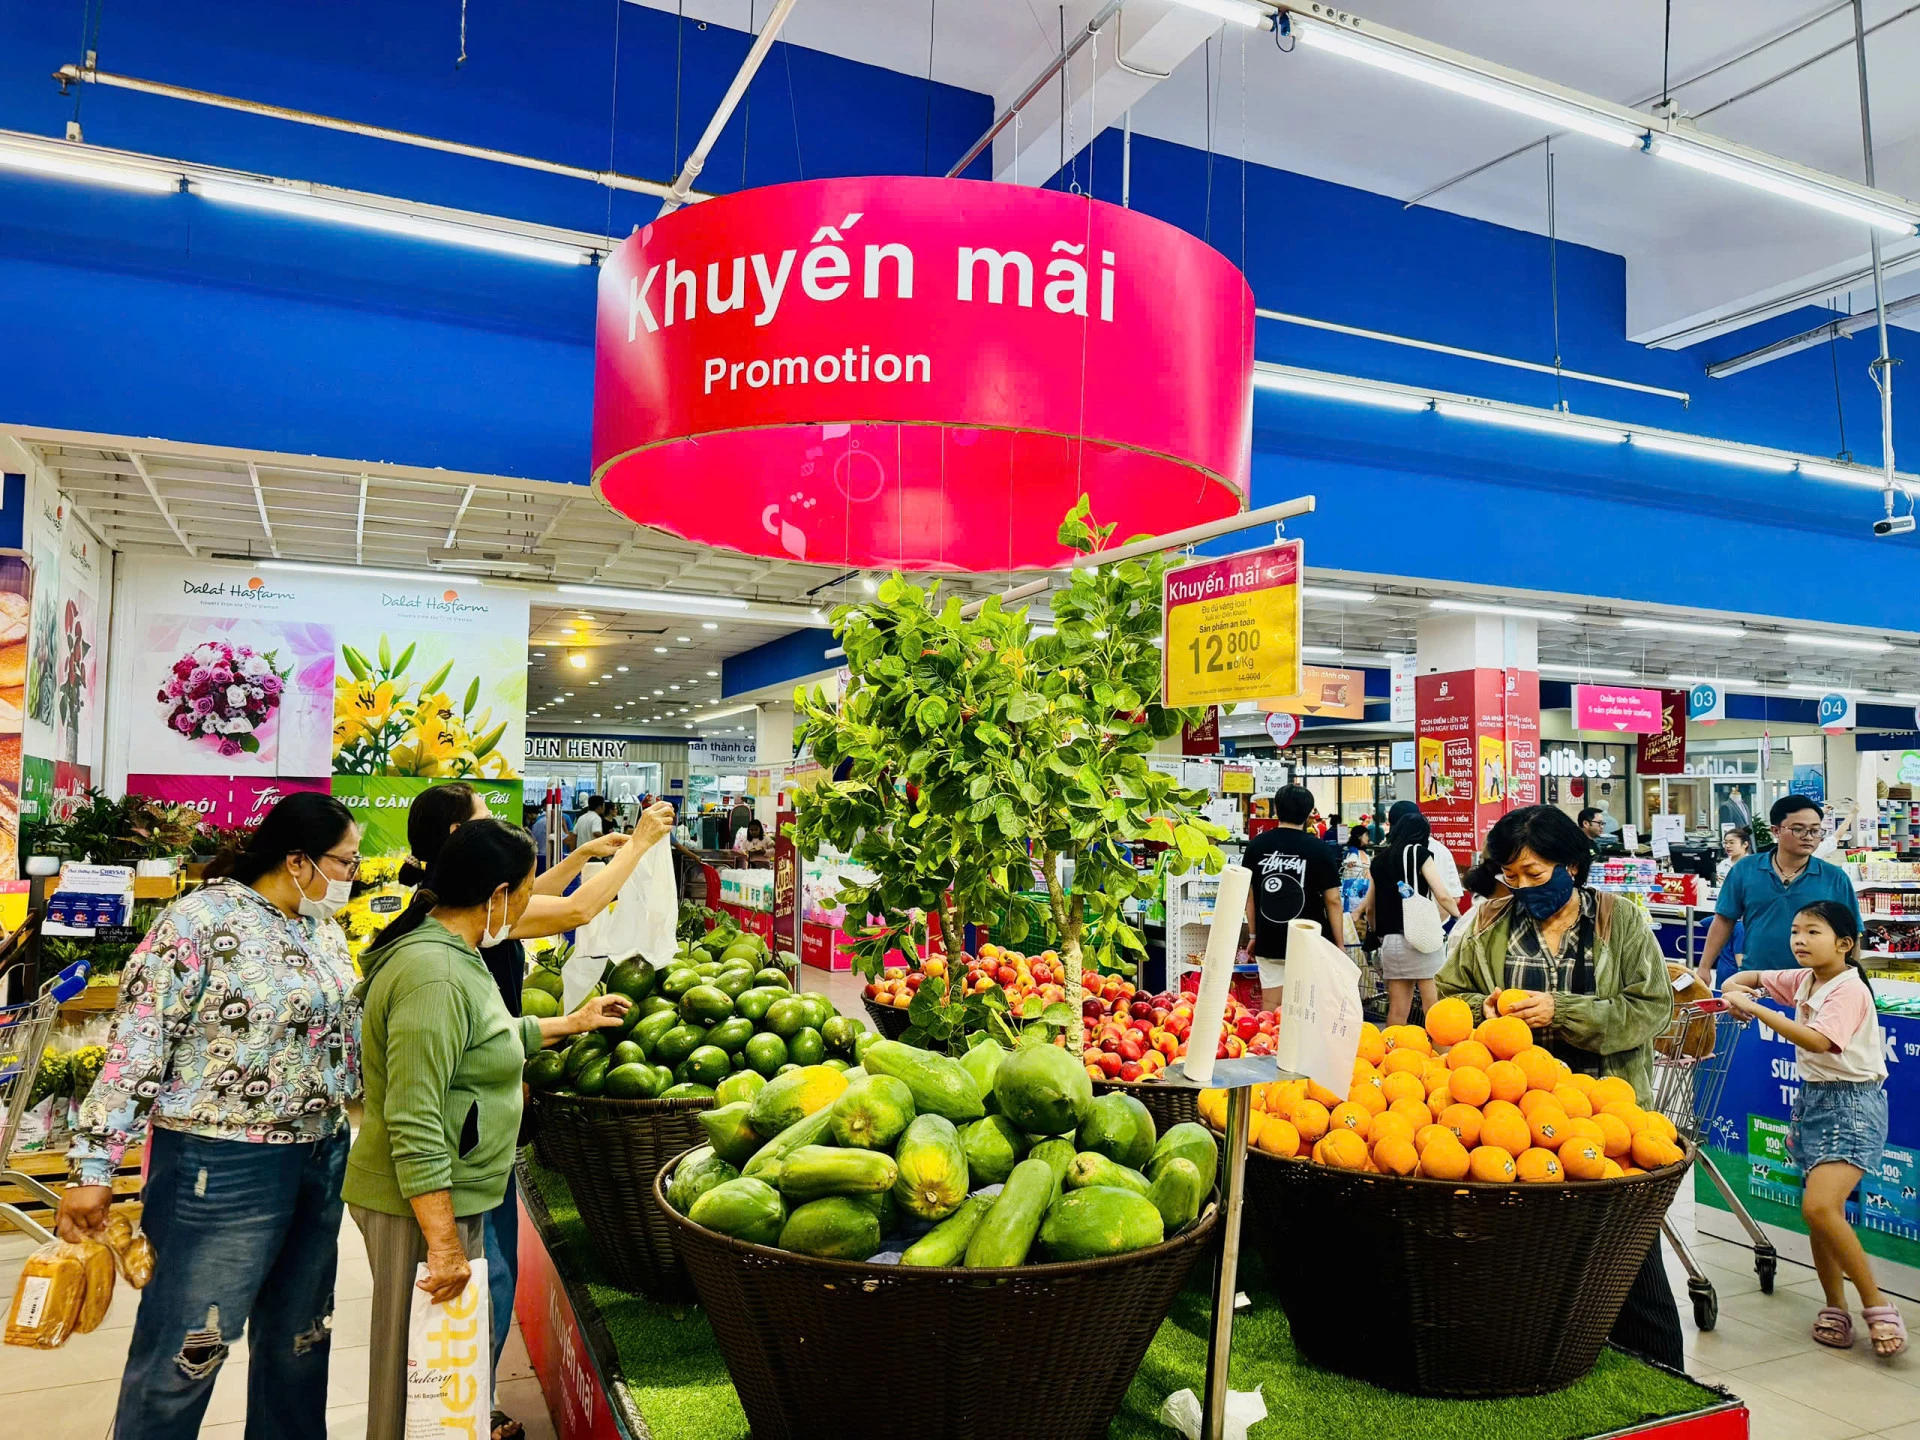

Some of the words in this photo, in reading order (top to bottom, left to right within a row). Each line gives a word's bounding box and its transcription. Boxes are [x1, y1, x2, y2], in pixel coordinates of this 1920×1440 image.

[626, 213, 913, 343] Khuyến
[957, 241, 1116, 323] mãi
[704, 344, 931, 394] Promotion
[1169, 571, 1224, 601] Khuyến
[1229, 564, 1260, 589] mãi
[183, 580, 225, 596] Dalat
[230, 584, 295, 601] Hasfarm
[382, 593, 421, 609] Dalat
[426, 596, 489, 614] Hasfarm
[1200, 624, 1211, 634] Sản
[1212, 620, 1229, 633] phẩm
[1230, 621, 1239, 629] an
[1240, 618, 1256, 627] toàn
[1338, 673, 1350, 681] cho
[1693, 691, 1713, 708] 03
[1821, 701, 1843, 716] 04
[1420, 718, 1433, 726] TÍCH
[1433, 716, 1447, 725] ĐIỂM
[1459, 723, 1469, 731] ĐÃI
[525, 738, 561, 757] OHN
[566, 739, 628, 759] HENRY
[710, 742, 741, 752] thành
[743, 742, 756, 753] cả
[1447, 746, 1473, 757] khách
[711, 754, 735, 762] Thank
[737, 754, 747, 762] for
[1452, 757, 1473, 767] hàng
[1538, 747, 1611, 778] ollibee
[1449, 768, 1473, 777] thành
[1455, 780, 1472, 788] viên
[335, 795, 370, 808] HOA
[100, 868, 126, 876] CHRYSAL
[1661, 879, 1684, 894] 2%
[1904, 1042, 1920, 1057] 197
[1771, 1058, 1800, 1082] SỮA
[1754, 1118, 1789, 1135] Vinamil
[1882, 1149, 1913, 1163] amilk
[550, 1283, 576, 1384] Khuyến
[576, 1361, 594, 1429] mãi
[408, 1369, 452, 1388] Bakery
[422, 1391, 448, 1400] Baguette
